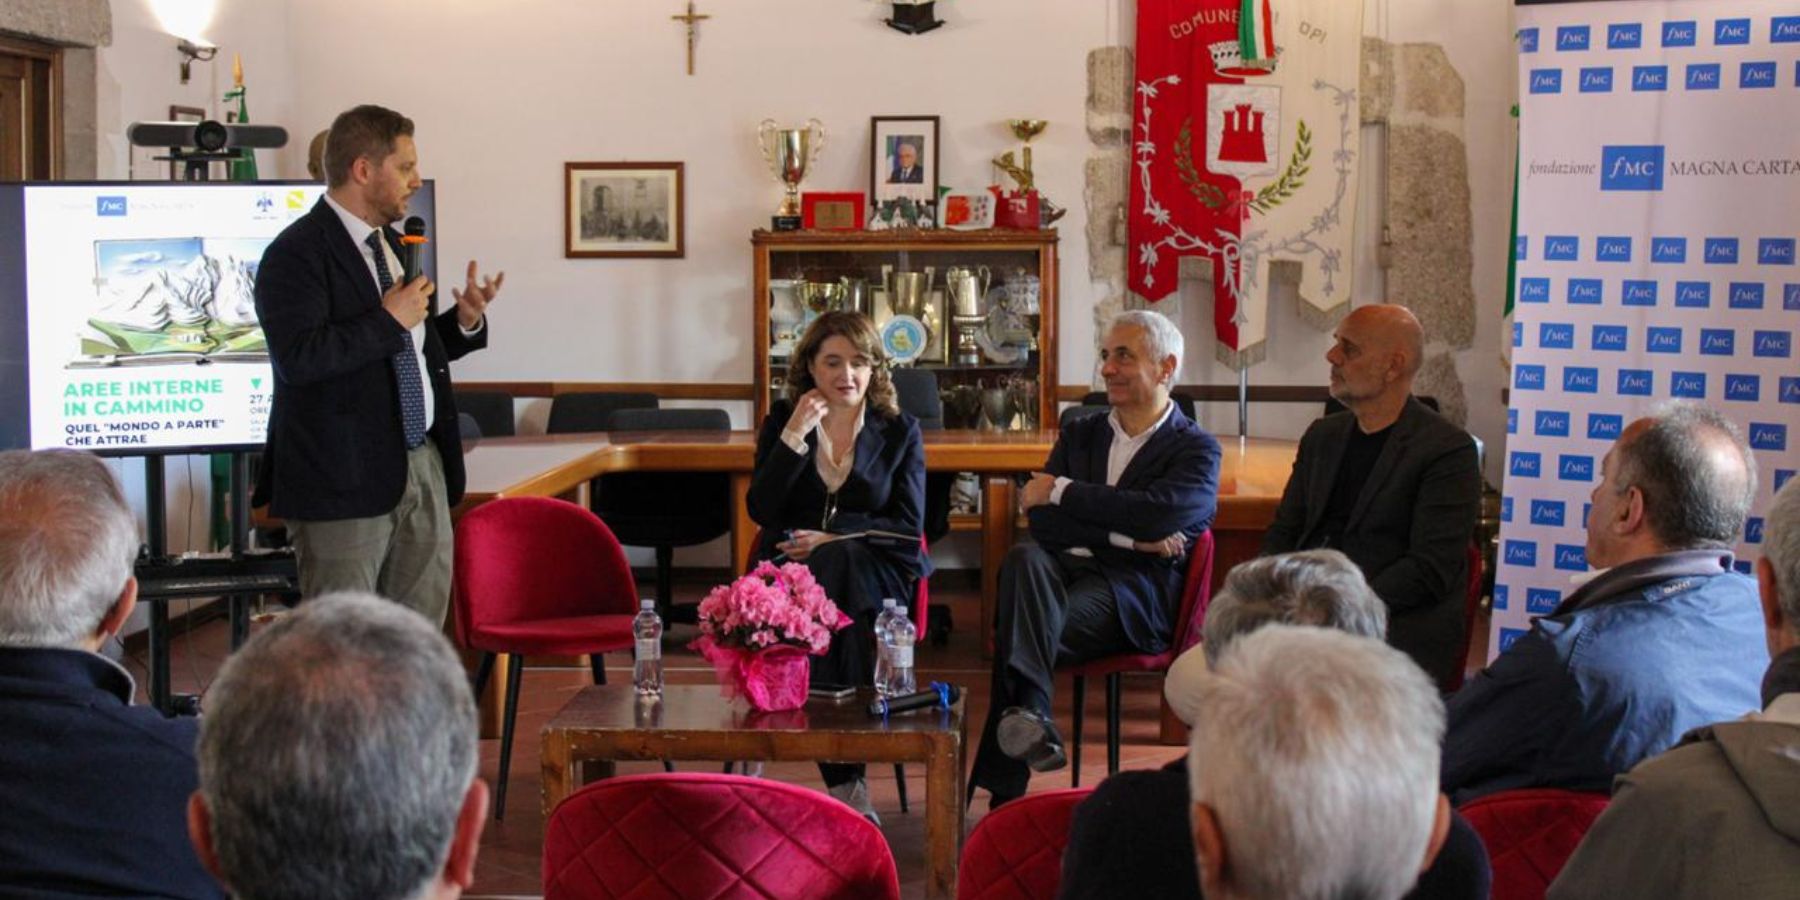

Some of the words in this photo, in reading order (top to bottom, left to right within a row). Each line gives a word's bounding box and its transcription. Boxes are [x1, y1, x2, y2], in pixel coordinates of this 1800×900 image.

[1169, 9, 1240, 39] COMUNE
[1299, 21, 1328, 45] OPI
[1527, 160, 1596, 179] fondazione
[1610, 156, 1655, 179] fMC
[1670, 161, 1738, 176] MAGNA
[1742, 160, 1800, 175] CARTA
[64, 382, 123, 398] AREE
[129, 379, 223, 396] INTERNE
[64, 401, 87, 416] IN
[94, 398, 205, 416] CAMMINO
[250, 395, 264, 404] 27
[65, 423, 100, 434] QUEL
[104, 420, 160, 432] "MONDO
[164, 421, 174, 430] A
[177, 419, 225, 430] PARTE"
[65, 436, 92, 446] CHE
[96, 434, 148, 445] ATTRAE
